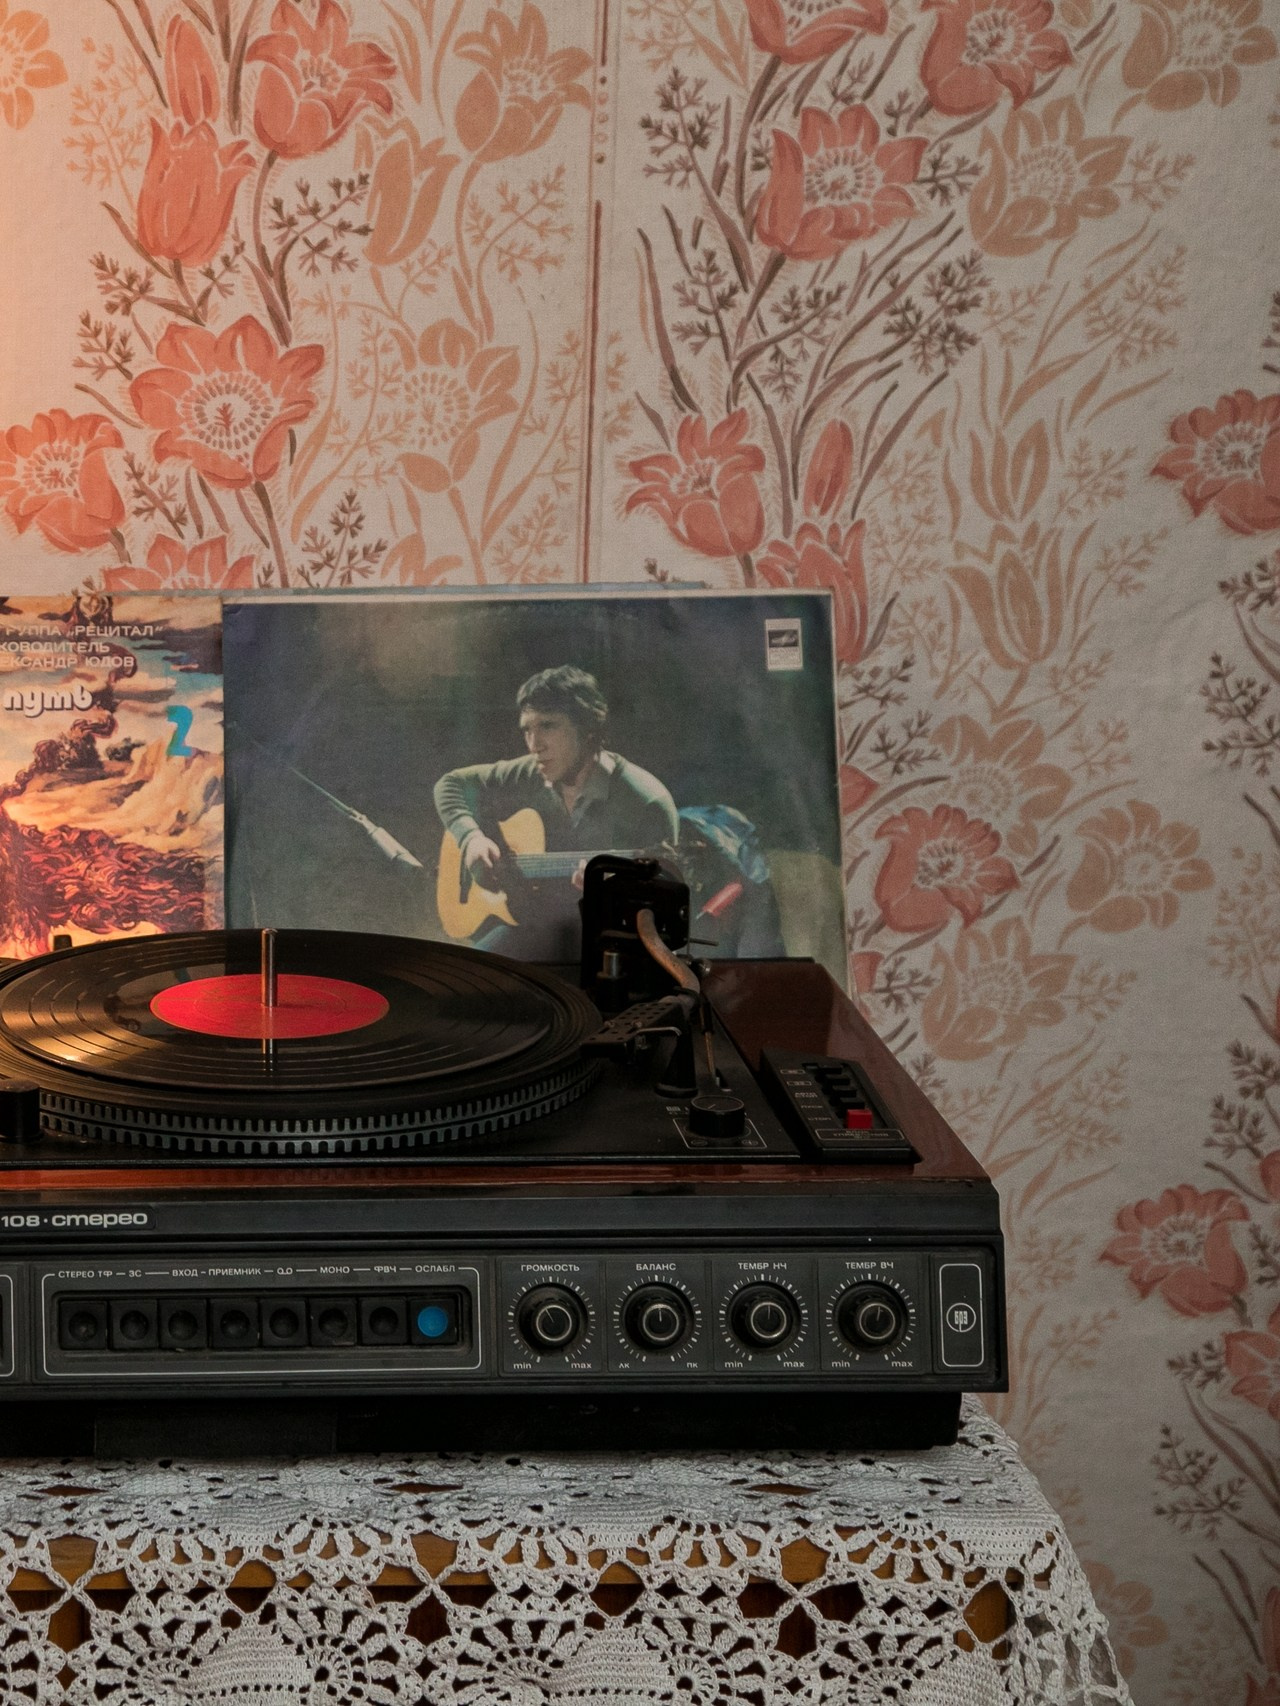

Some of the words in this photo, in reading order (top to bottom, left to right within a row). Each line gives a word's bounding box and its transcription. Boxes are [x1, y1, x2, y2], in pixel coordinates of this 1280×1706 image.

[85, 656, 135, 669] ЮДОВ
[520, 1264, 580, 1272] ГРОМКОСТЬ
[636, 1263, 677, 1271] БАЛАНС
[738, 1262, 769, 1270] ТЕМБР
[773, 1262, 787, 1270] НЧ
[845, 1261, 876, 1270] ТЕМБР
[880, 1261, 894, 1269] ВЧ
[58, 1270, 94, 1279] СТЕРЕО
[172, 1268, 198, 1277] ВХОД
[208, 1267, 261, 1277] ПРИЕМНИК
[320, 1266, 350, 1274] МОНО
[373, 1265, 397, 1273] ФВЧ
[415, 1264, 456, 1273] ОСЛАБЛ
[513, 1362, 532, 1370] min
[724, 1361, 743, 1369] min
[831, 1361, 850, 1369] min
